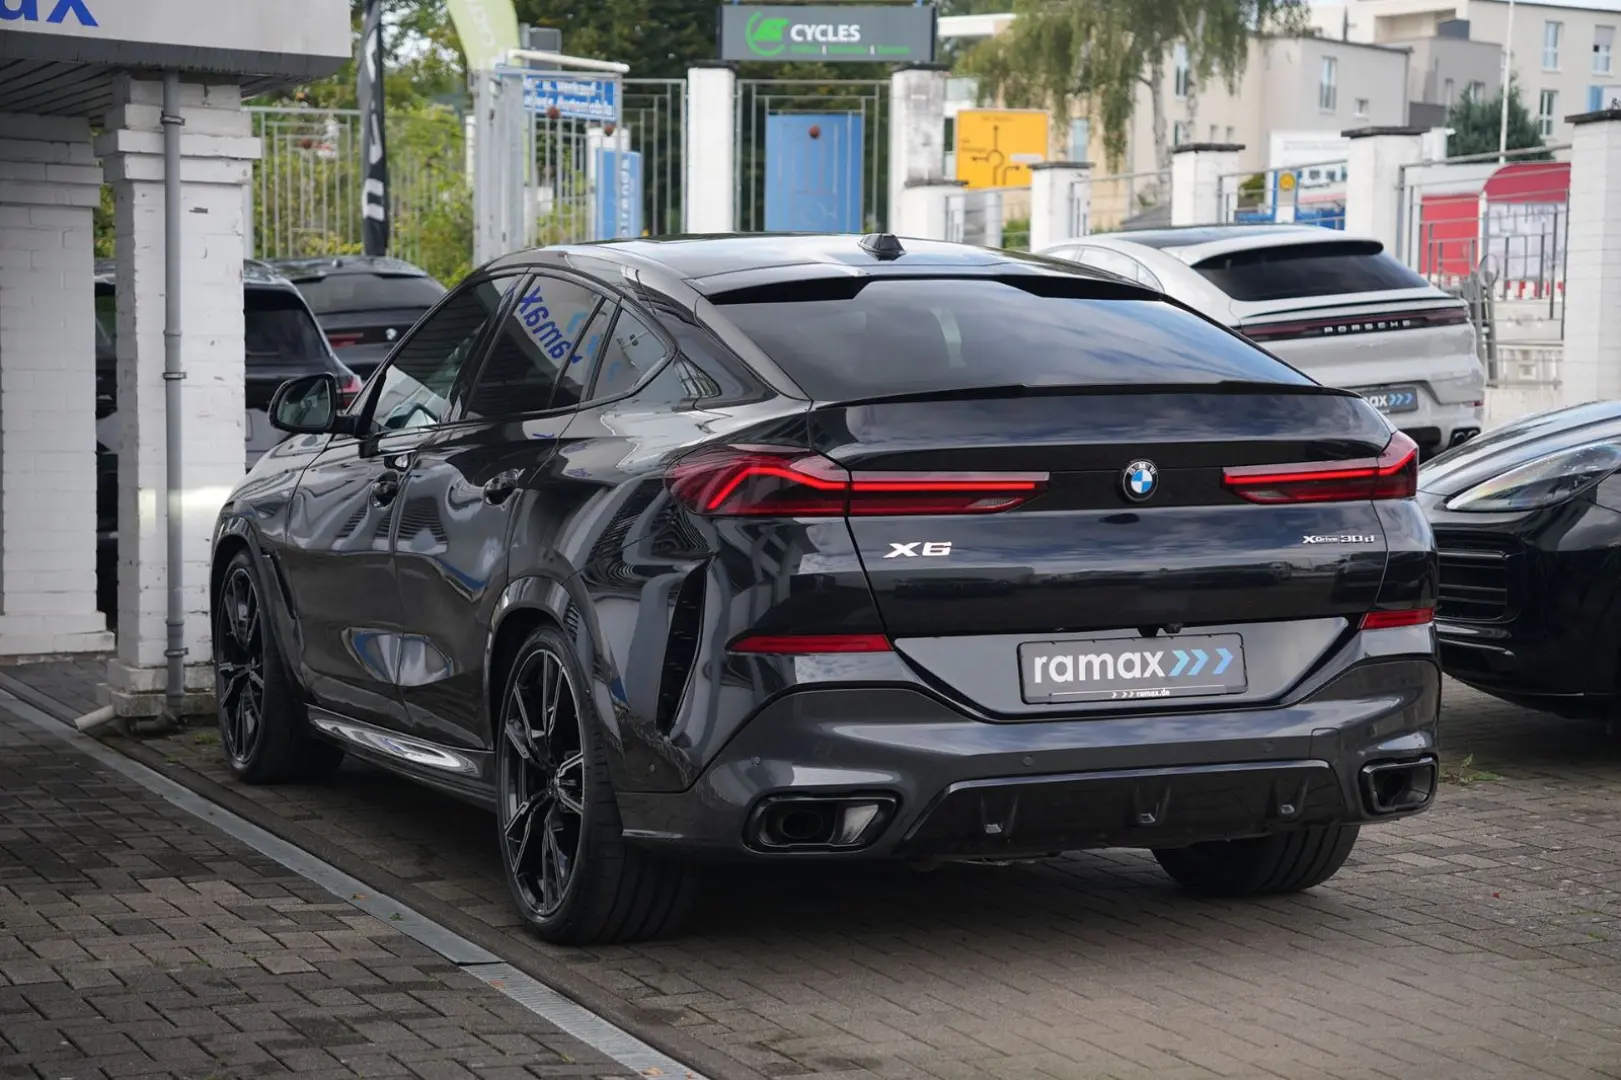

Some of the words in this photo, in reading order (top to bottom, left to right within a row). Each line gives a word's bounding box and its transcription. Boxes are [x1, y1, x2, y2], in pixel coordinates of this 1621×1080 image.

[790, 24, 862, 42] CYCLES
[1324, 320, 1411, 333] PORSCHE
[882, 541, 952, 559] X6
[1033, 650, 1166, 684] ramax
[1136, 688, 1171, 697] ramax.de
